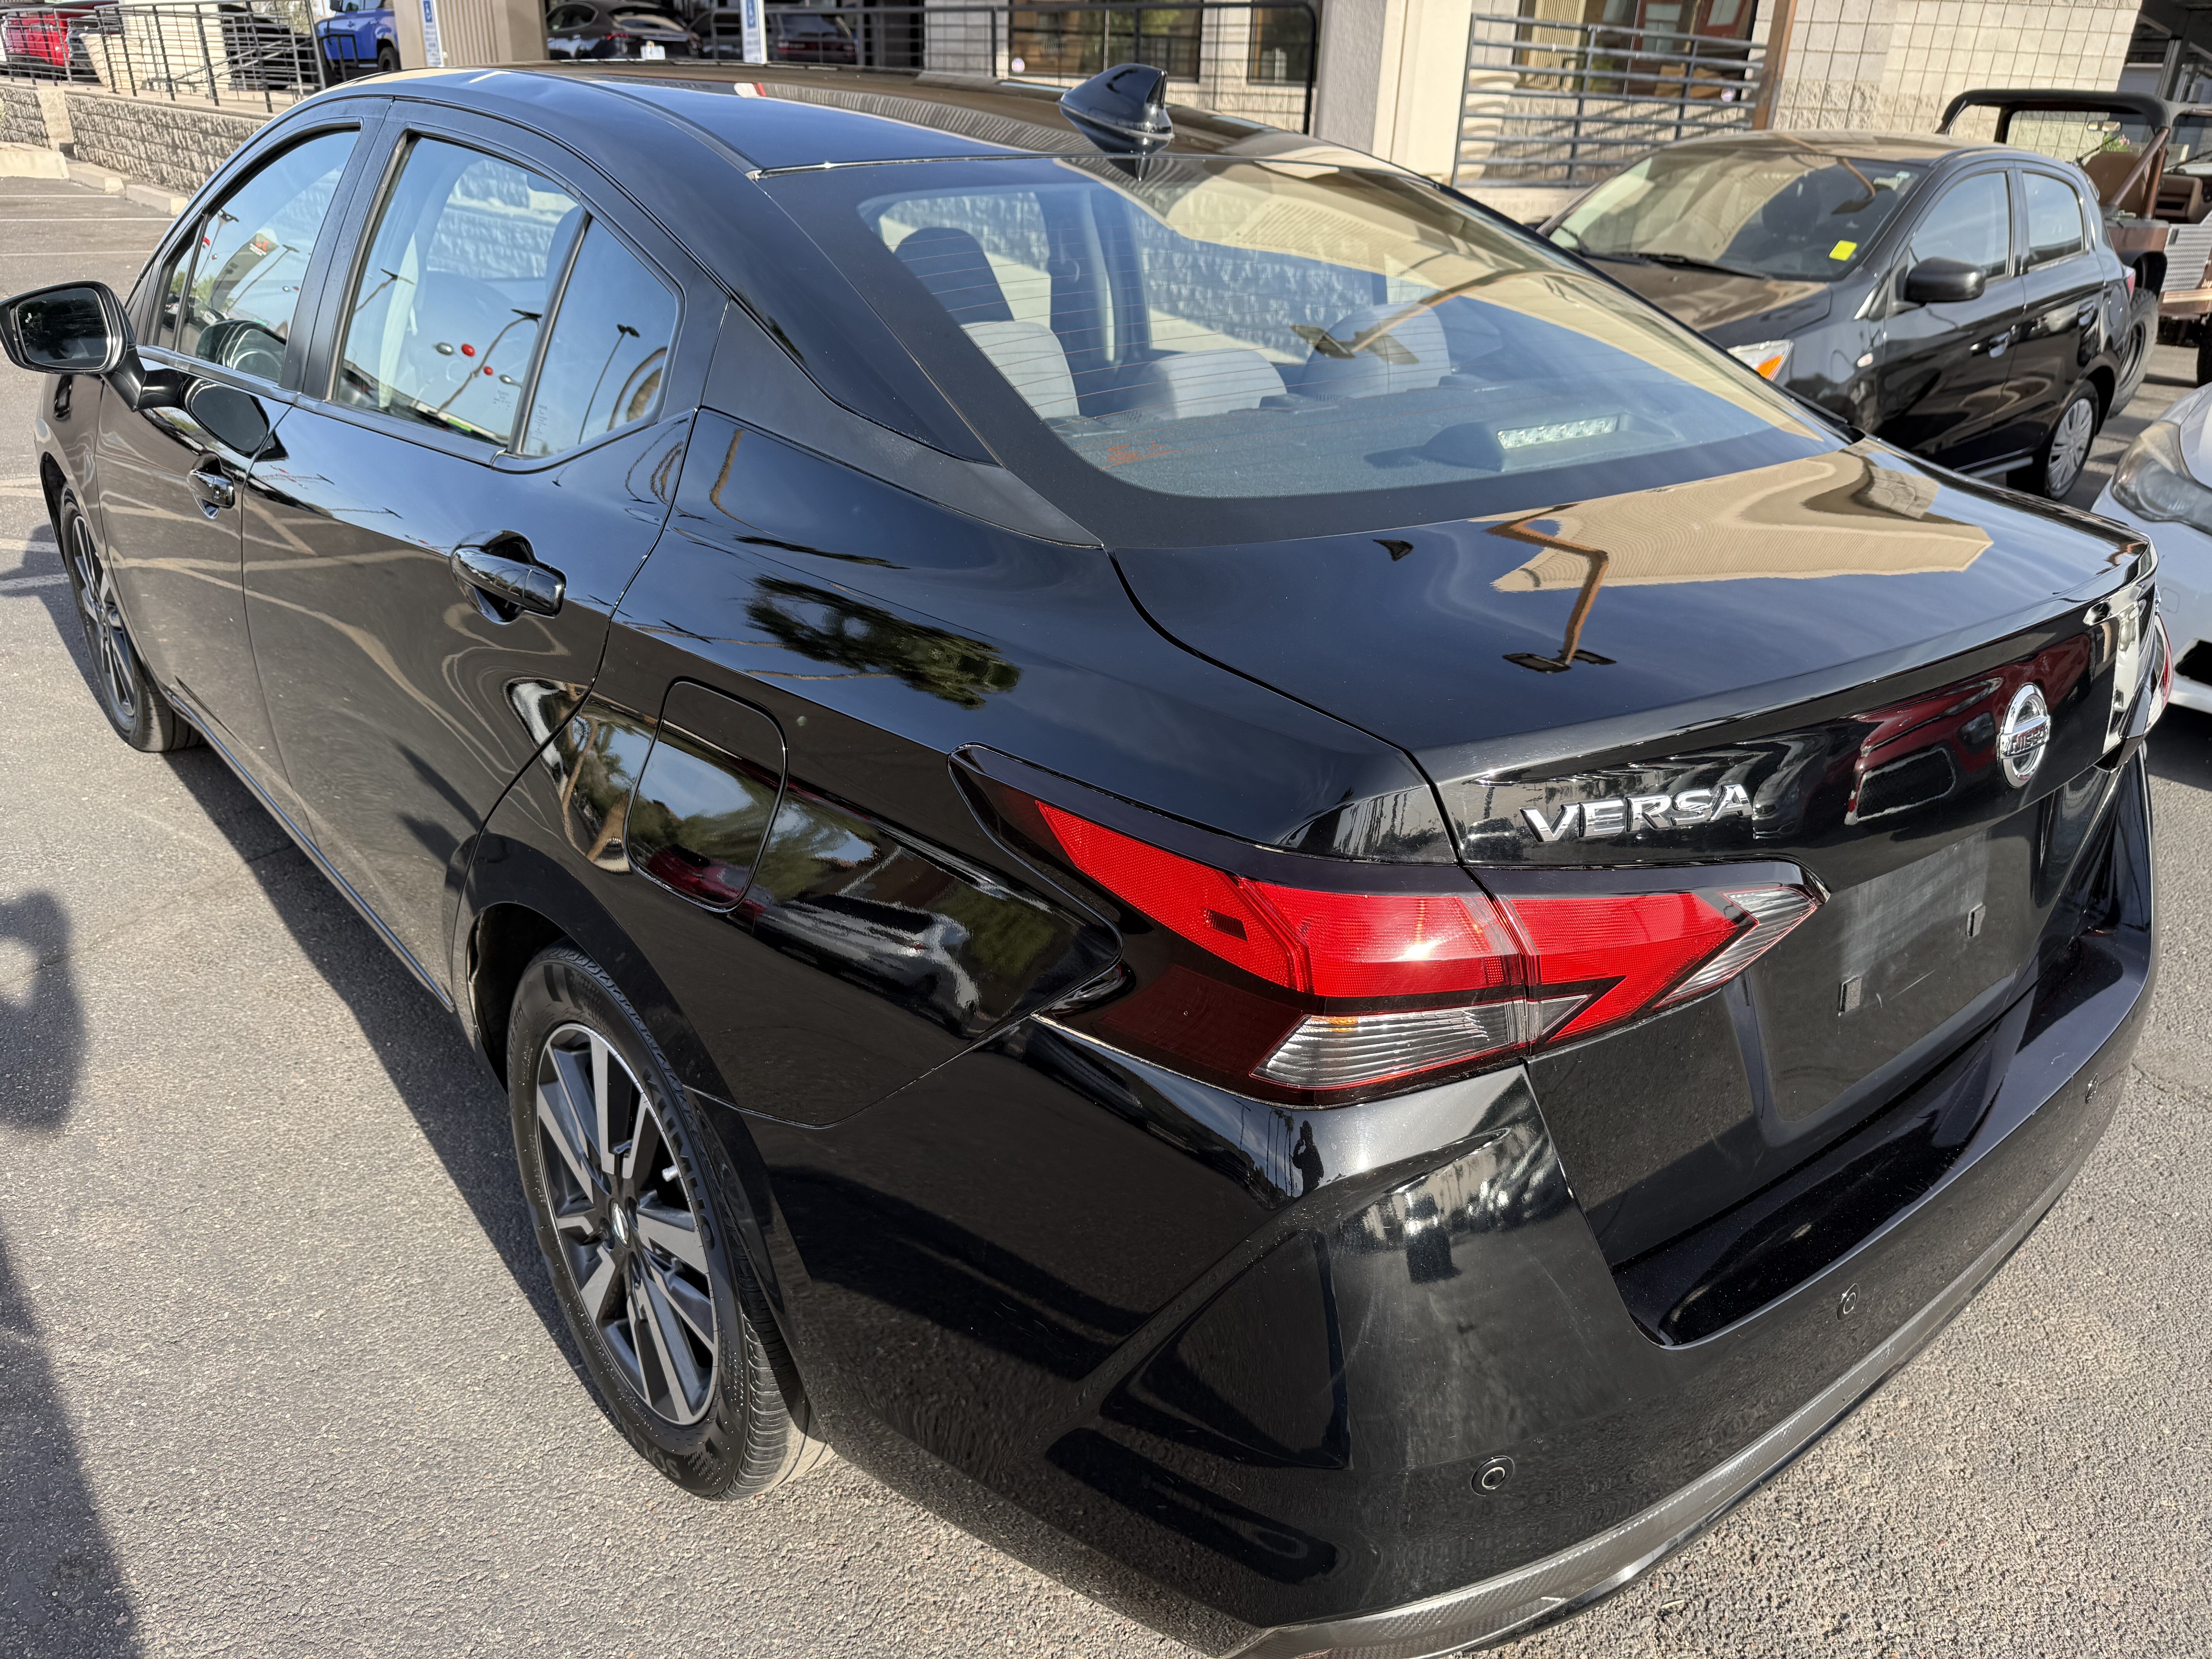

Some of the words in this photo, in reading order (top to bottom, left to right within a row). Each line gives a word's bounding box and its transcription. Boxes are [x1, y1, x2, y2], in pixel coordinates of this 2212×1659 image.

[2001, 720, 2050, 756] NISSAN
[1519, 783, 1754, 843] VERSA
[642, 1067, 715, 1250] KUMHO
